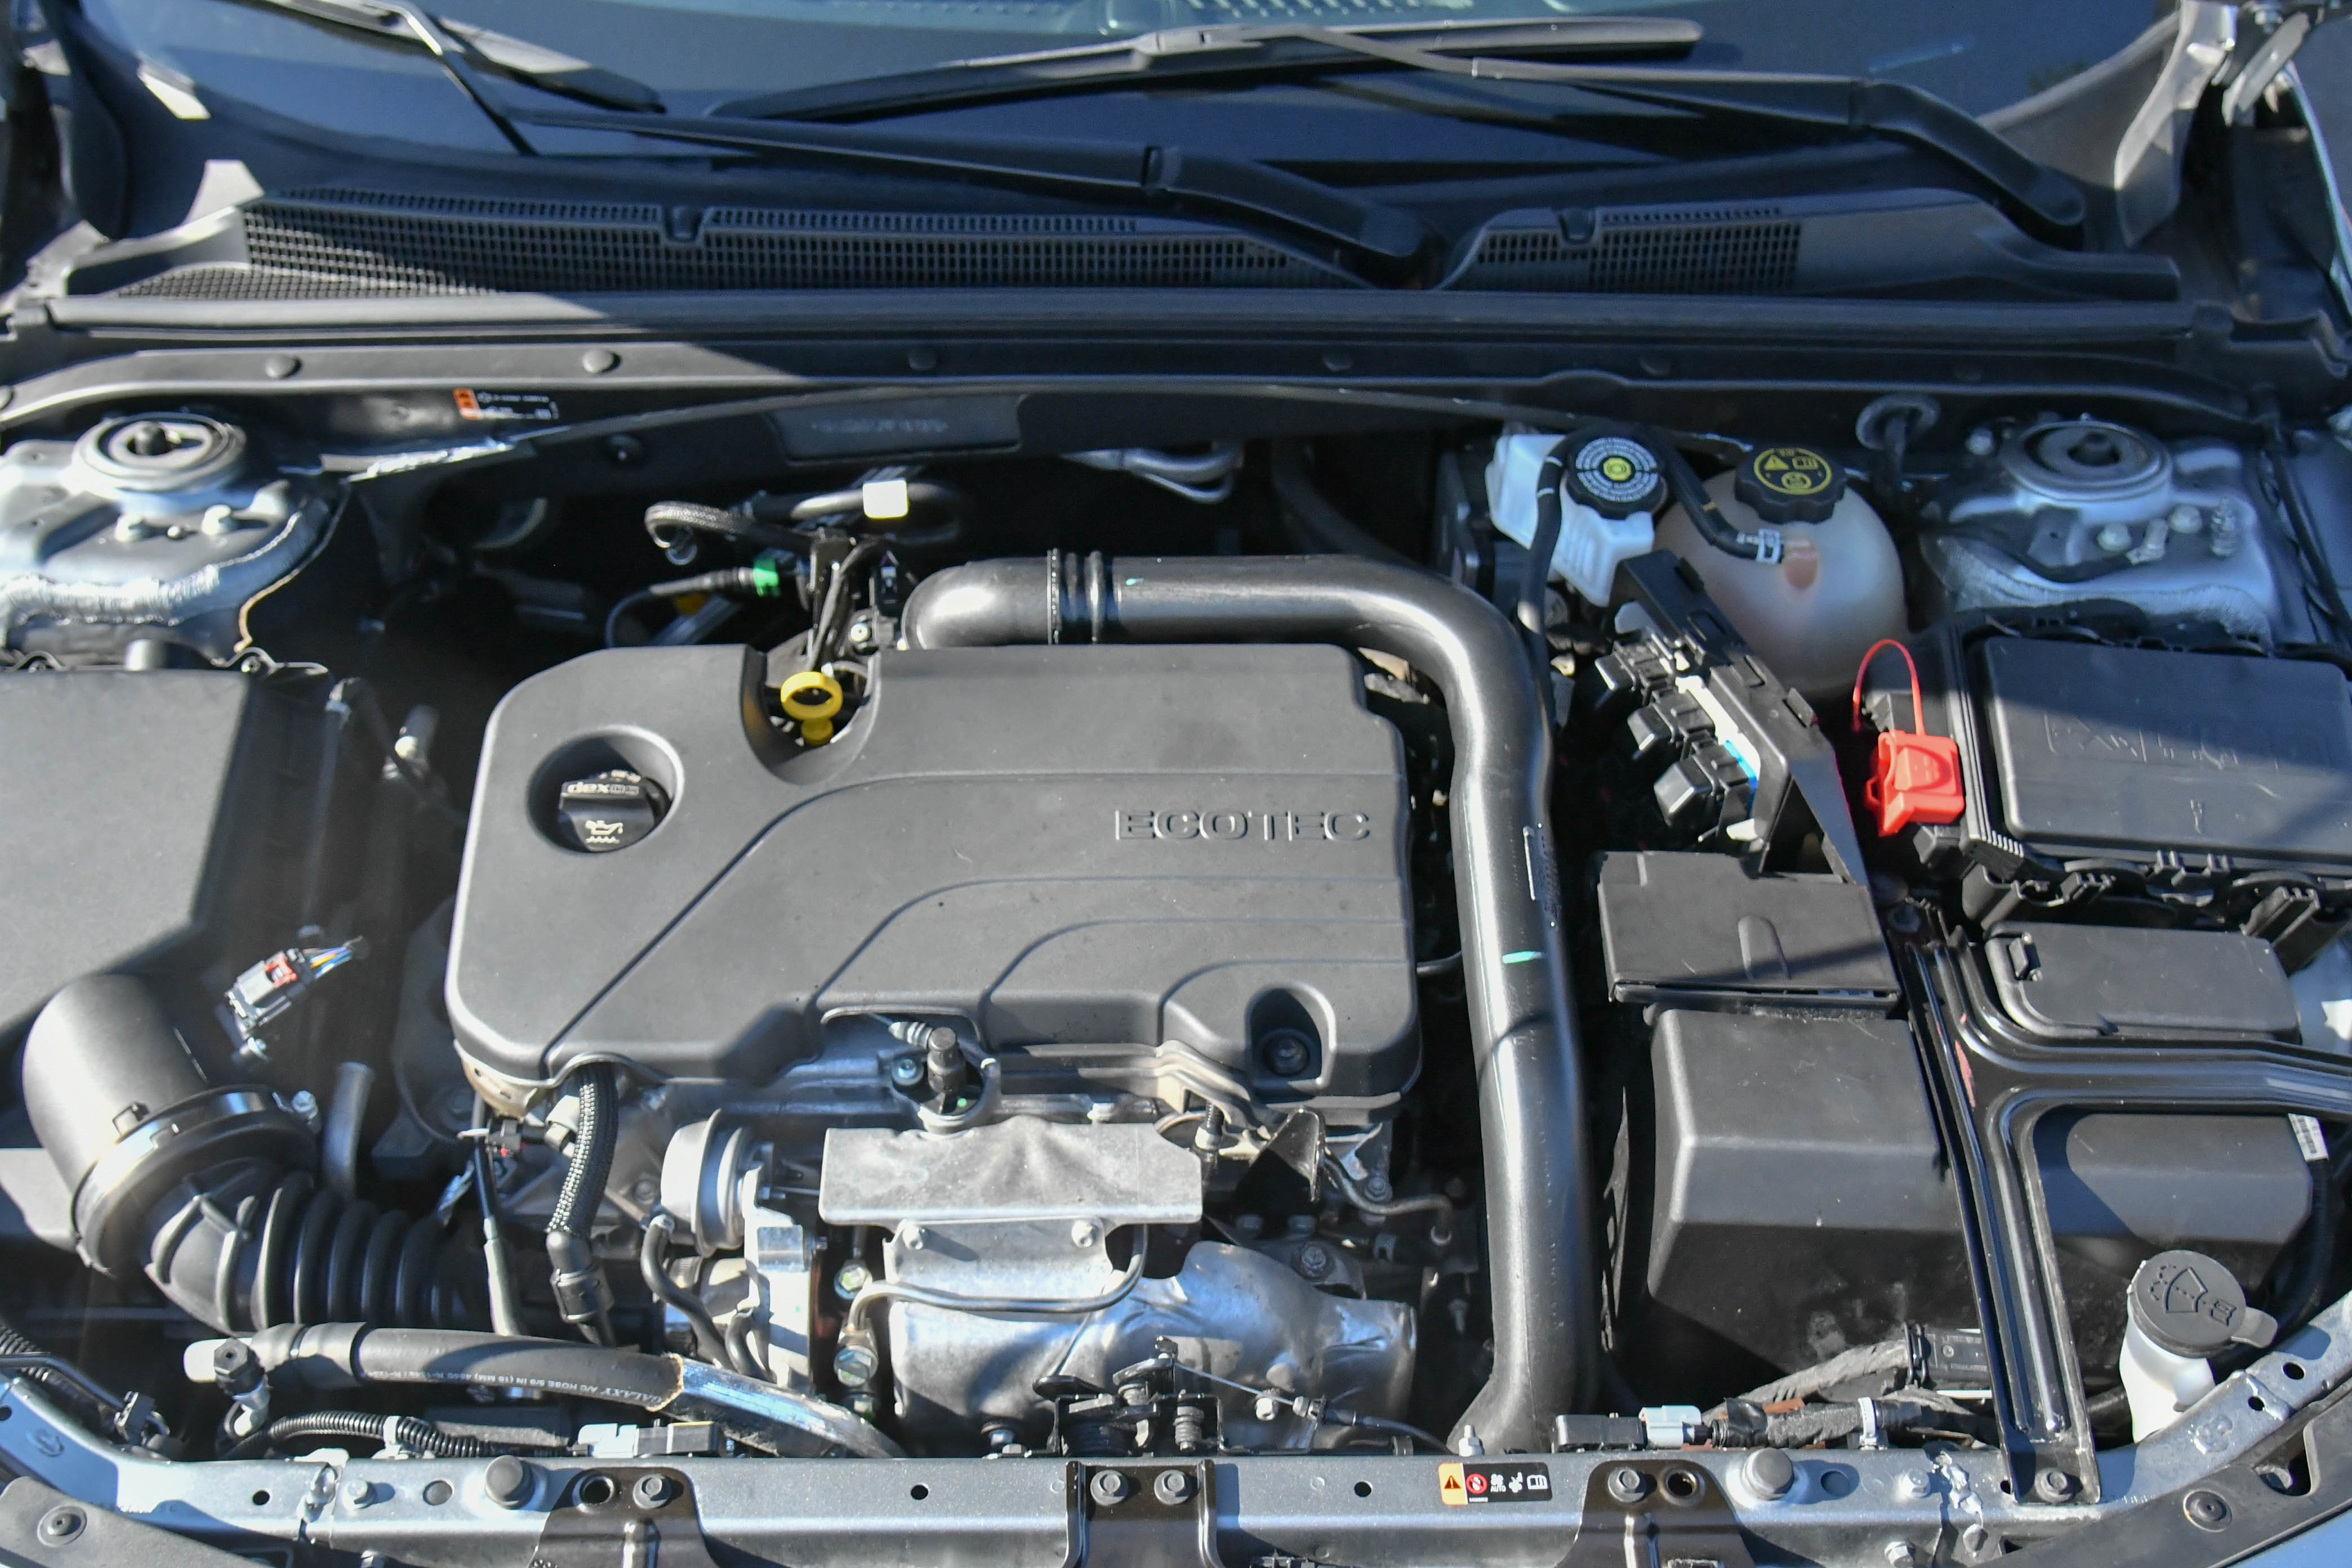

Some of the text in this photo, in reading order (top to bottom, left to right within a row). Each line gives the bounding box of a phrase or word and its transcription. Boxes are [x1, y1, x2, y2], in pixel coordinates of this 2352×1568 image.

[567, 781, 640, 795] dexos
[1115, 810, 1370, 840] ECOTEC
[474, 1373, 496, 1382] MM)
[516, 1377, 527, 1385] IN
[547, 1380, 577, 1391] HOSE
[580, 1384, 599, 1393] A/C
[600, 1387, 662, 1403] GALAXY
